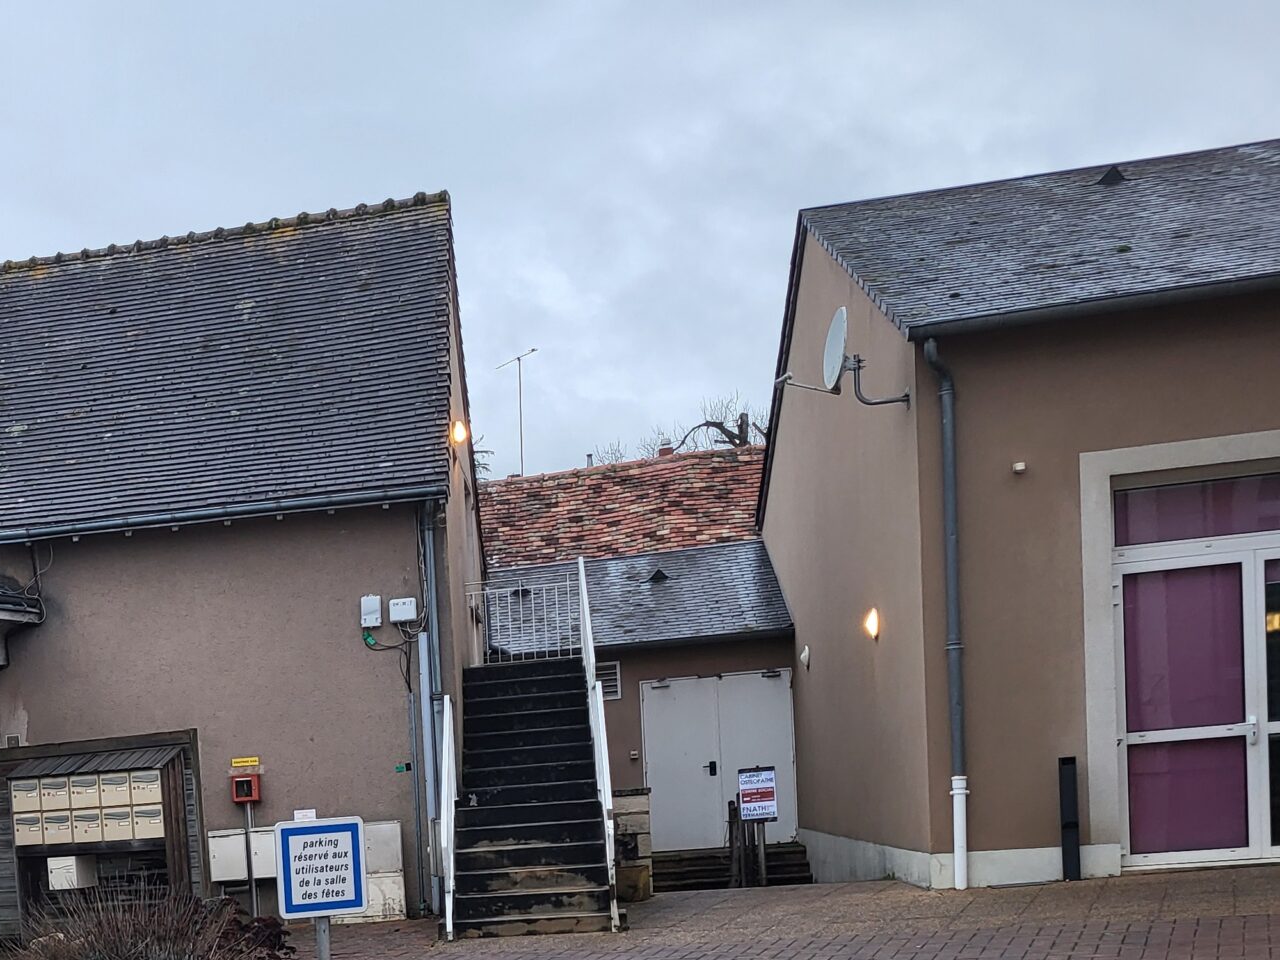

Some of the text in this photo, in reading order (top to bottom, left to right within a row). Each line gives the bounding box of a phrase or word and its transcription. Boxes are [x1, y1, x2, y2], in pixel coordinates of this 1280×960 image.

[742, 805, 767, 813] FNATH
[302, 837, 339, 851] parking
[293, 850, 349, 862] réservé aux
[295, 863, 349, 875] utilisateurs
[299, 874, 347, 888] de la salle
[301, 888, 345, 900] des fêtes
